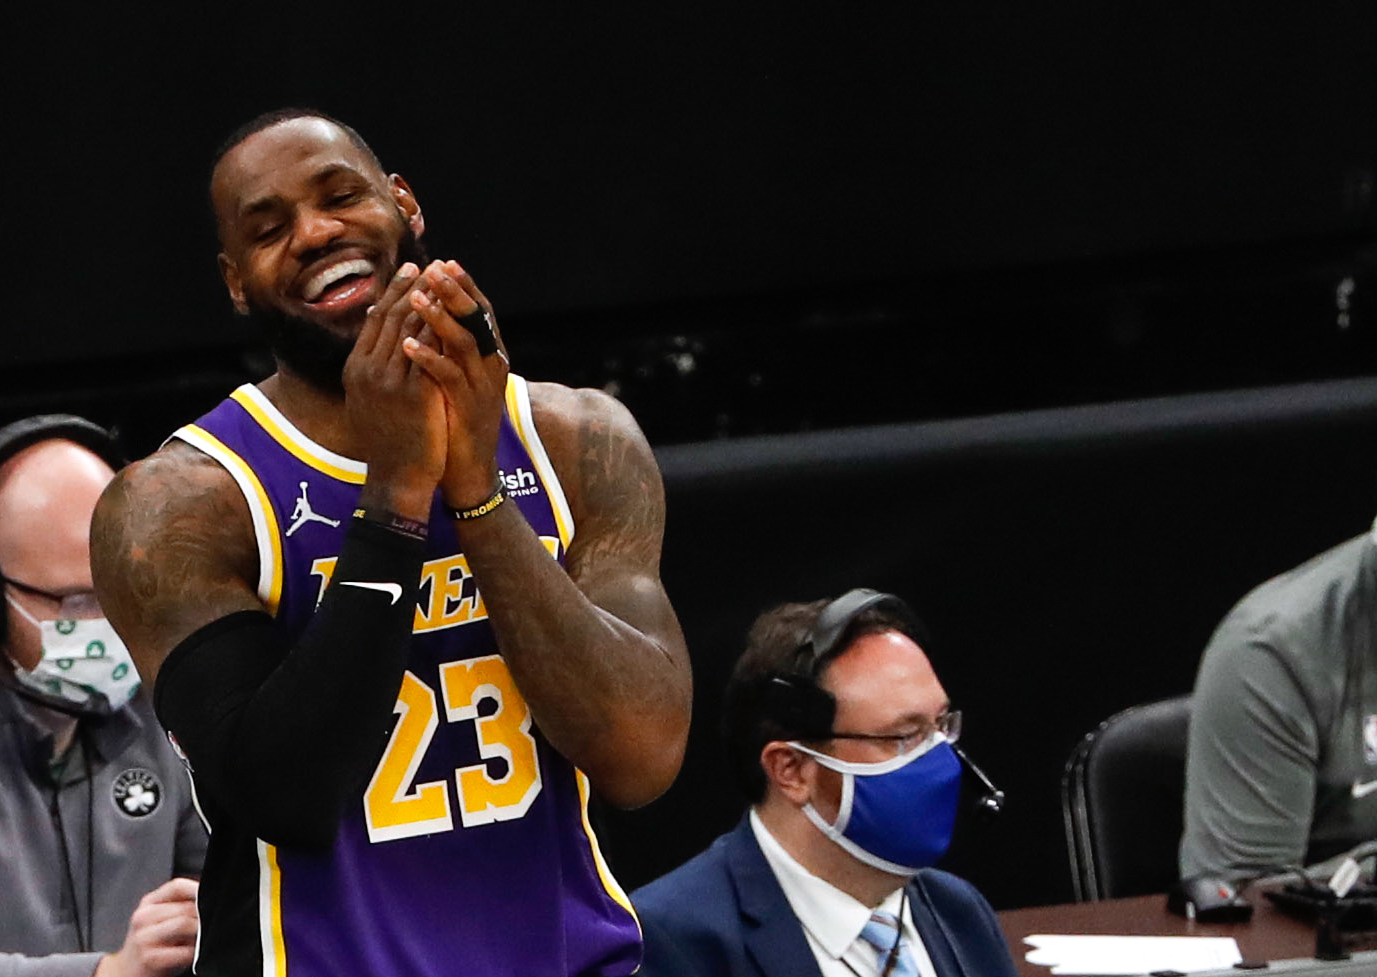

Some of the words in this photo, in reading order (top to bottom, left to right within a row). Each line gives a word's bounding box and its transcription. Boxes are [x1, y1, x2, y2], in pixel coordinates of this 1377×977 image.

[499, 468, 536, 490] ish
[507, 486, 539, 498] PING
[463, 493, 505, 519] PROMISE
[363, 654, 543, 843] 23
